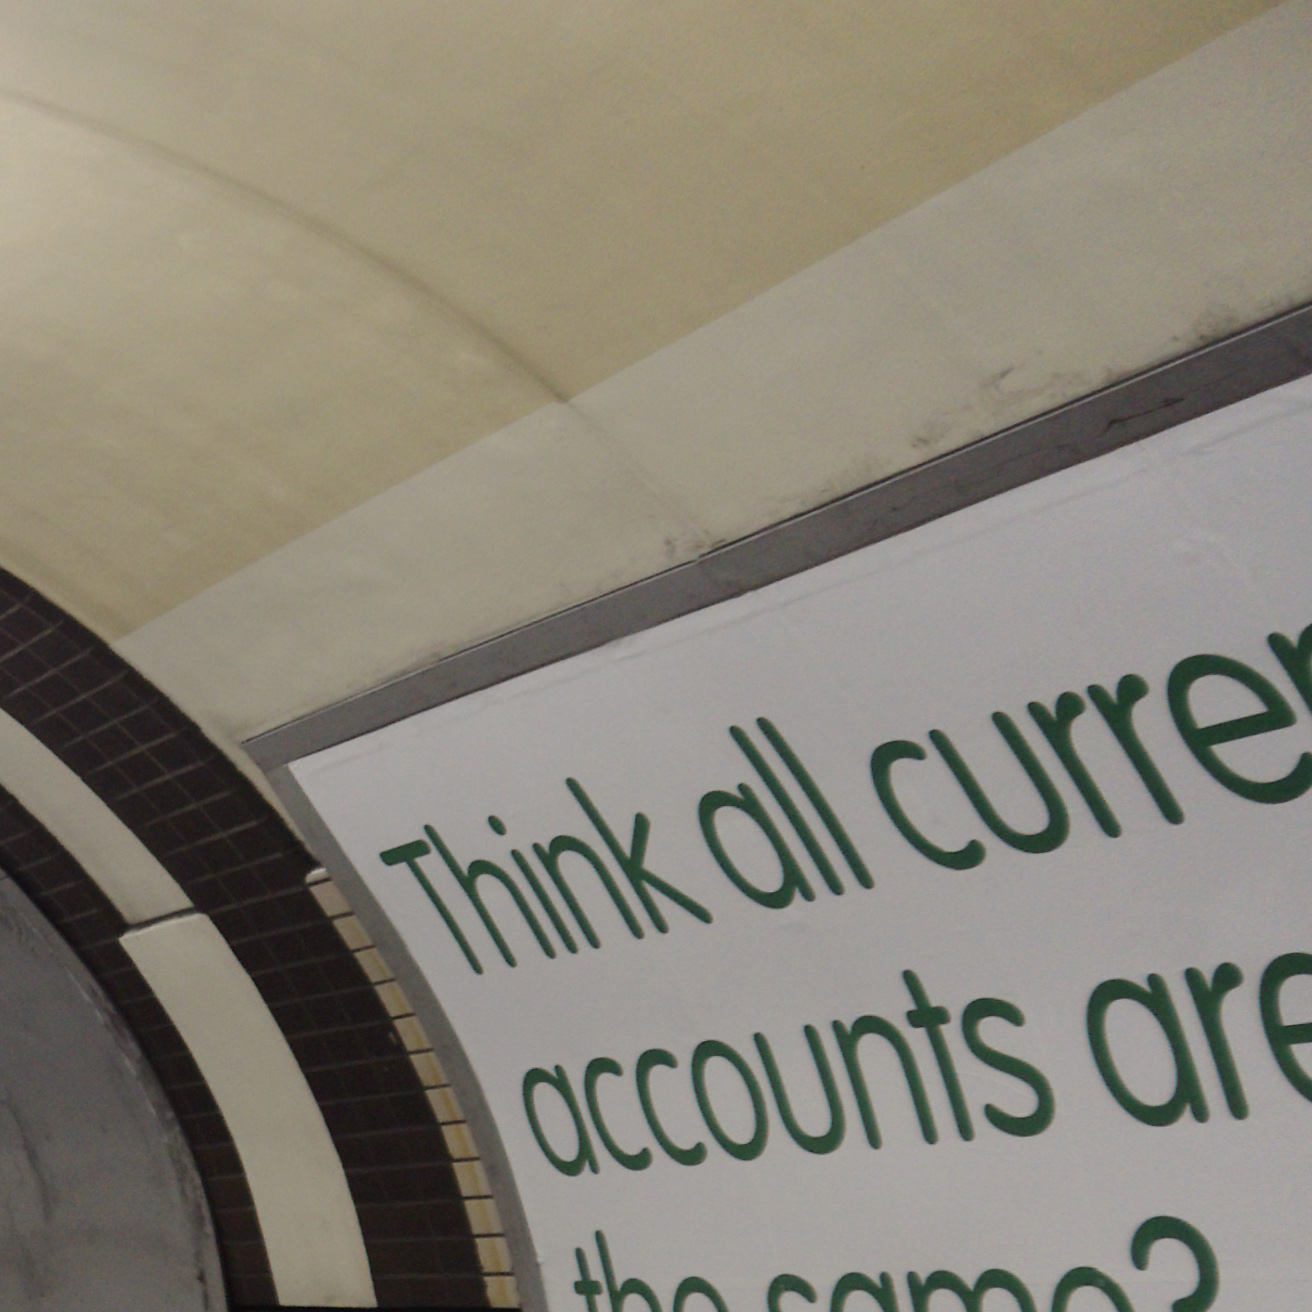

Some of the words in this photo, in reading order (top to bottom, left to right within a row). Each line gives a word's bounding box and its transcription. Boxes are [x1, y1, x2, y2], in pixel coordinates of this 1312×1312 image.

[379, 777, 714, 976] Think
[697, 716, 875, 911] all
[521, 970, 1056, 1177] accounts
